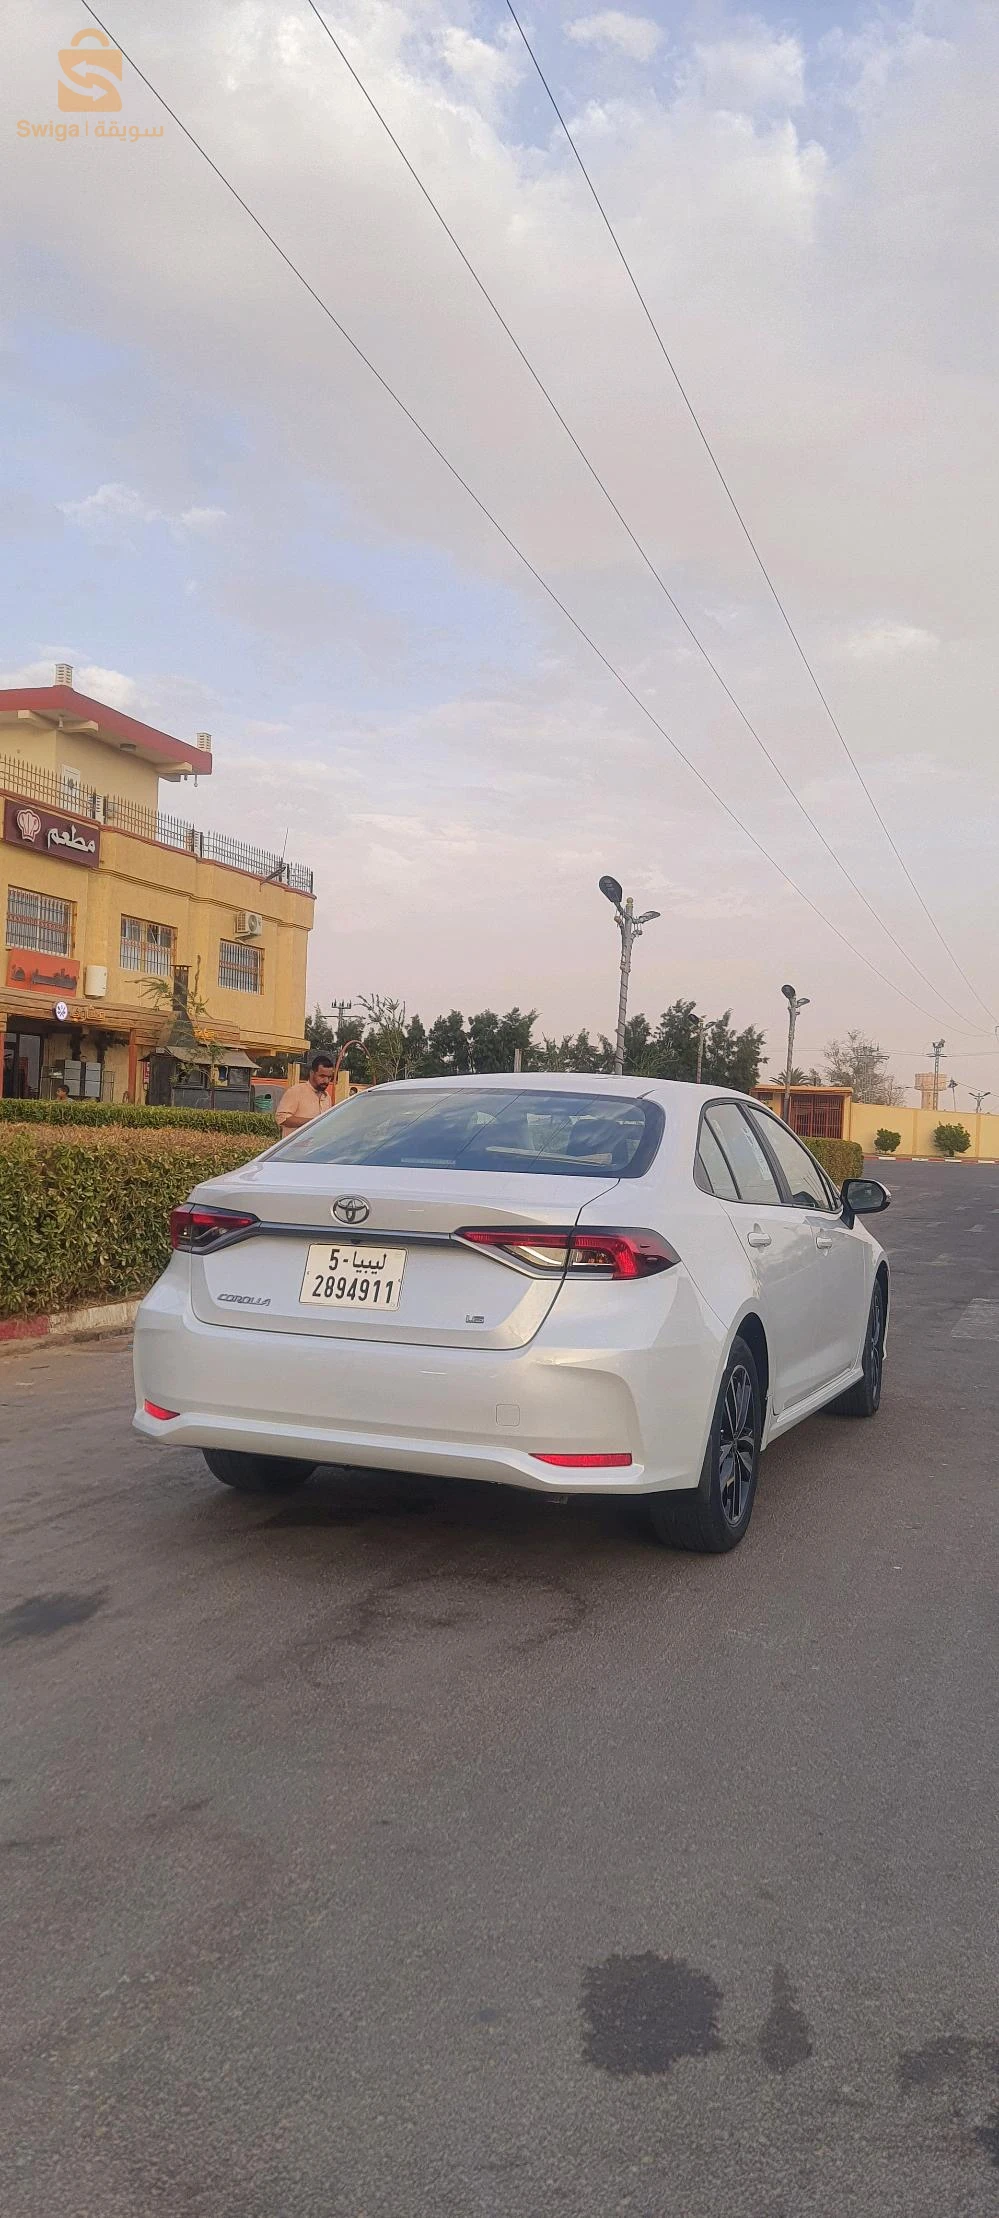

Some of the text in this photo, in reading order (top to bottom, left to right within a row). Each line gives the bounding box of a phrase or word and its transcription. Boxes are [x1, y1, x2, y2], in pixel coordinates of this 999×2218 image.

[47, 824, 96, 853] مطعم
[217, 1293, 272, 1307] COROLLA
[312, 1274, 394, 1304] 2894911
